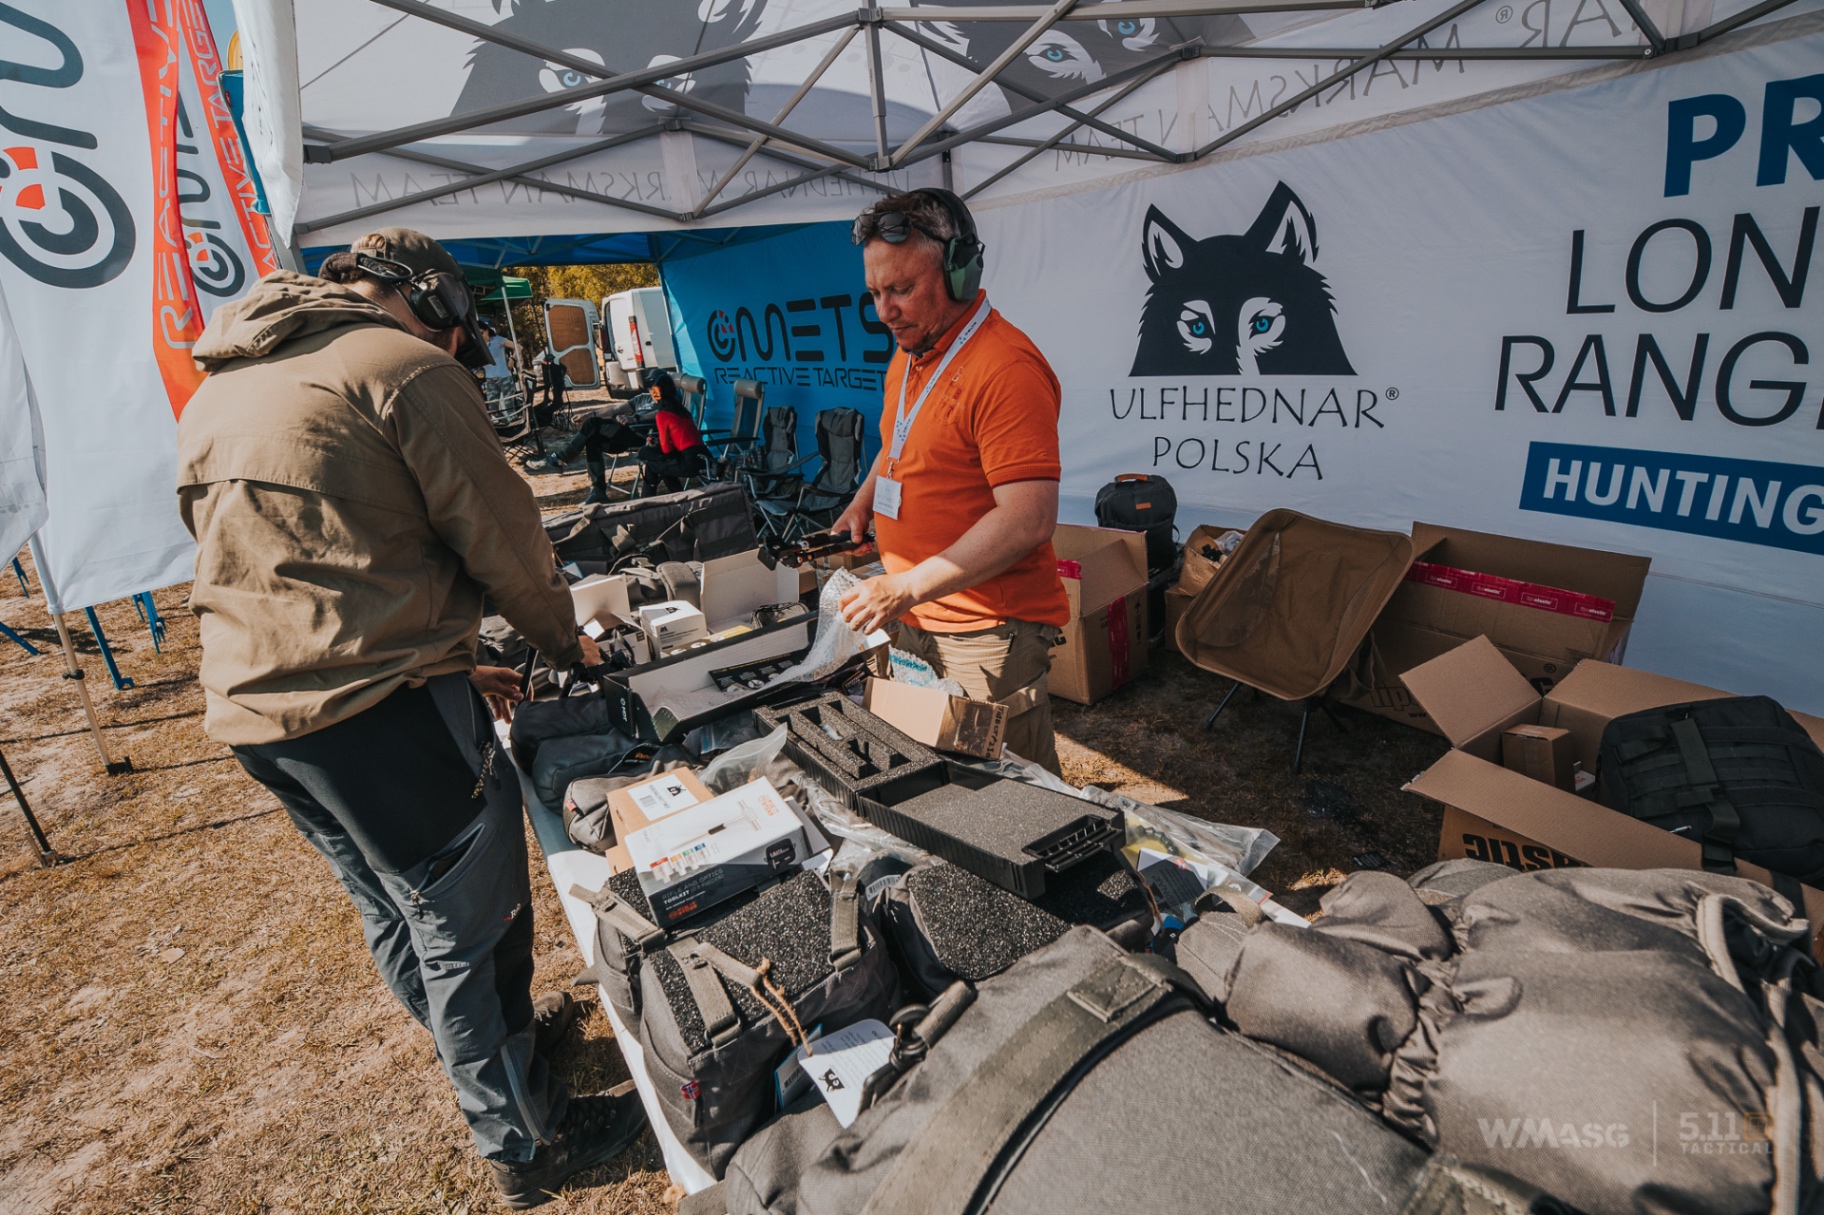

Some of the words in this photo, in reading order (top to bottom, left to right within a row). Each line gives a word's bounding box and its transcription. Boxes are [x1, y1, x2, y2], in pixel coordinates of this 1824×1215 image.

[714, 366, 811, 387] REACTIVE
[1494, 331, 1824, 430] RANG
[1153, 436, 1323, 480] POLSKA
[1543, 458, 1824, 535] HUNTING
[699, 868, 723, 883] OPTICS
[664, 889, 690, 905] TOOLKIT
